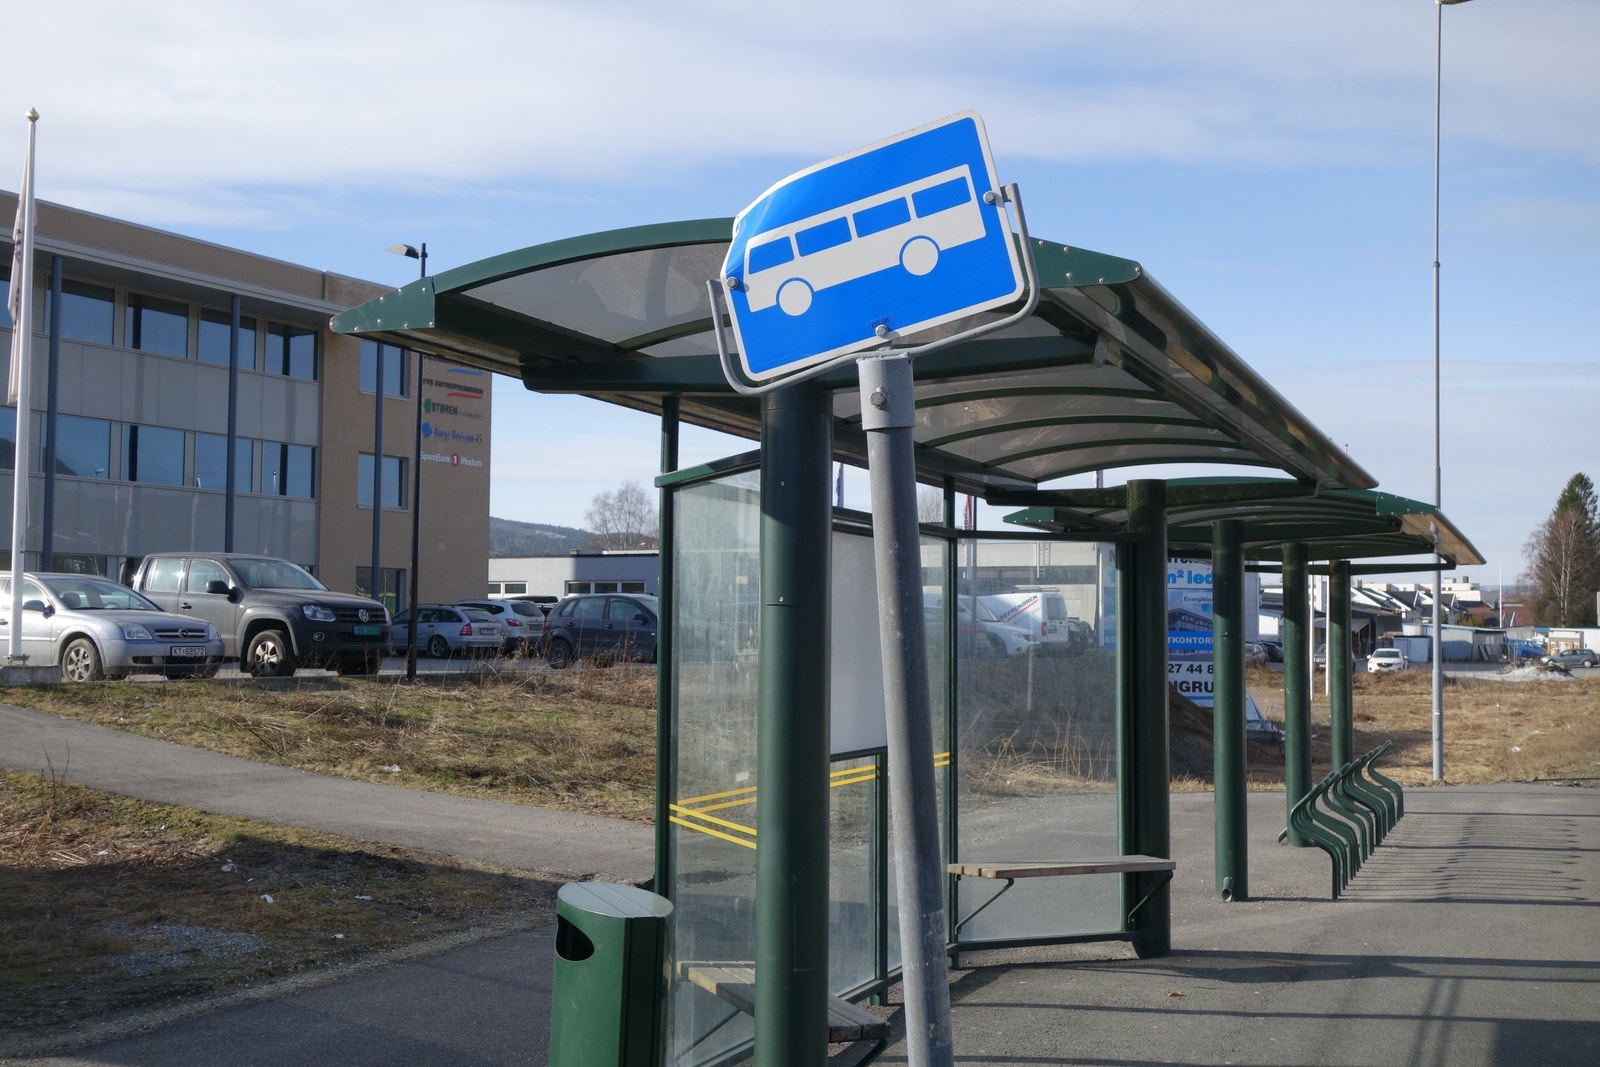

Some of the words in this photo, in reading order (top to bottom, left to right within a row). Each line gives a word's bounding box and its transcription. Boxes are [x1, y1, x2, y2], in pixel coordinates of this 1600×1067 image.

[475, 434, 483, 444] AS
[461, 457, 483, 467] Modum
[1186, 664, 1203, 674] 44
